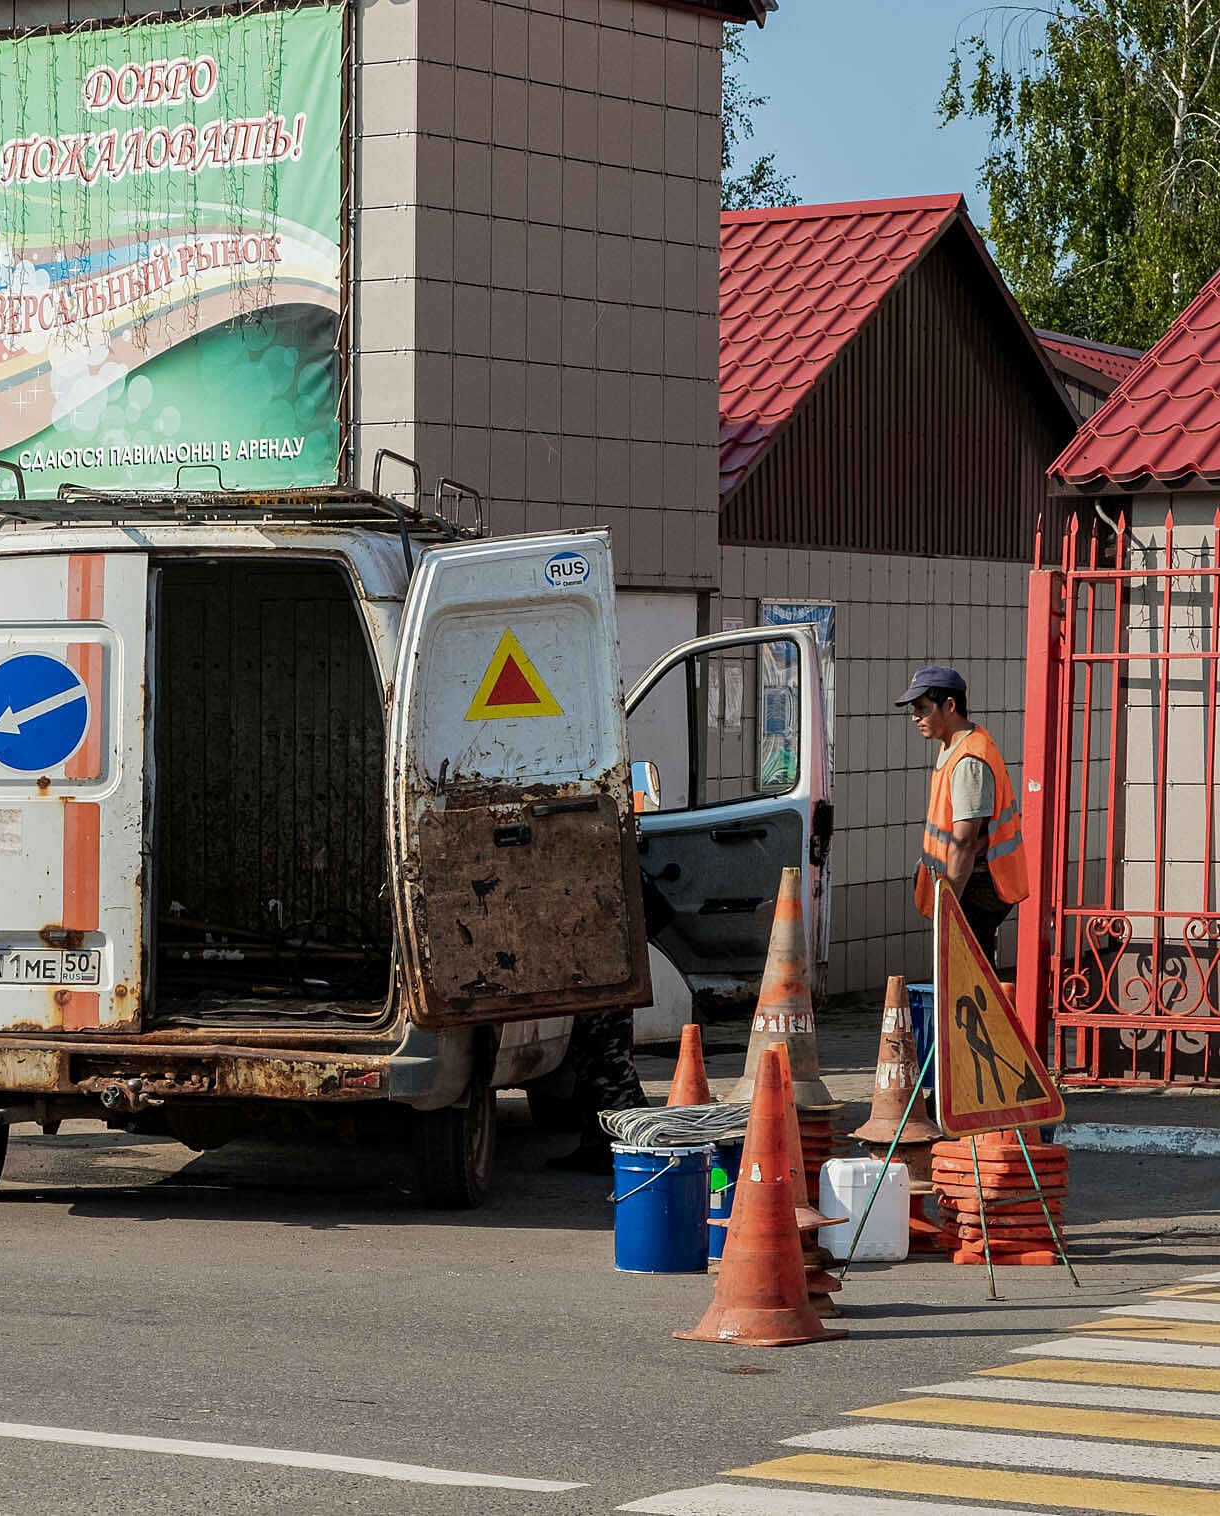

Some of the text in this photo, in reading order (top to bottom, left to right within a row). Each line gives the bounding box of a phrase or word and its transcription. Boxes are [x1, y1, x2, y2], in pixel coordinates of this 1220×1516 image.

[84, 57, 217, 109] ДОБРО
[0, 114, 305, 183] ПОЖАЛОВАТЬ!
[176, 234, 283, 278] РЫНОК
[18, 436, 306, 472] СДАЮТСЯ ПАВИЛЬОНЫ В АРЕНДУ
[550, 561, 585, 578] RUS
[62, 973, 82, 982] RUS
[65, 953, 90, 973] 50
